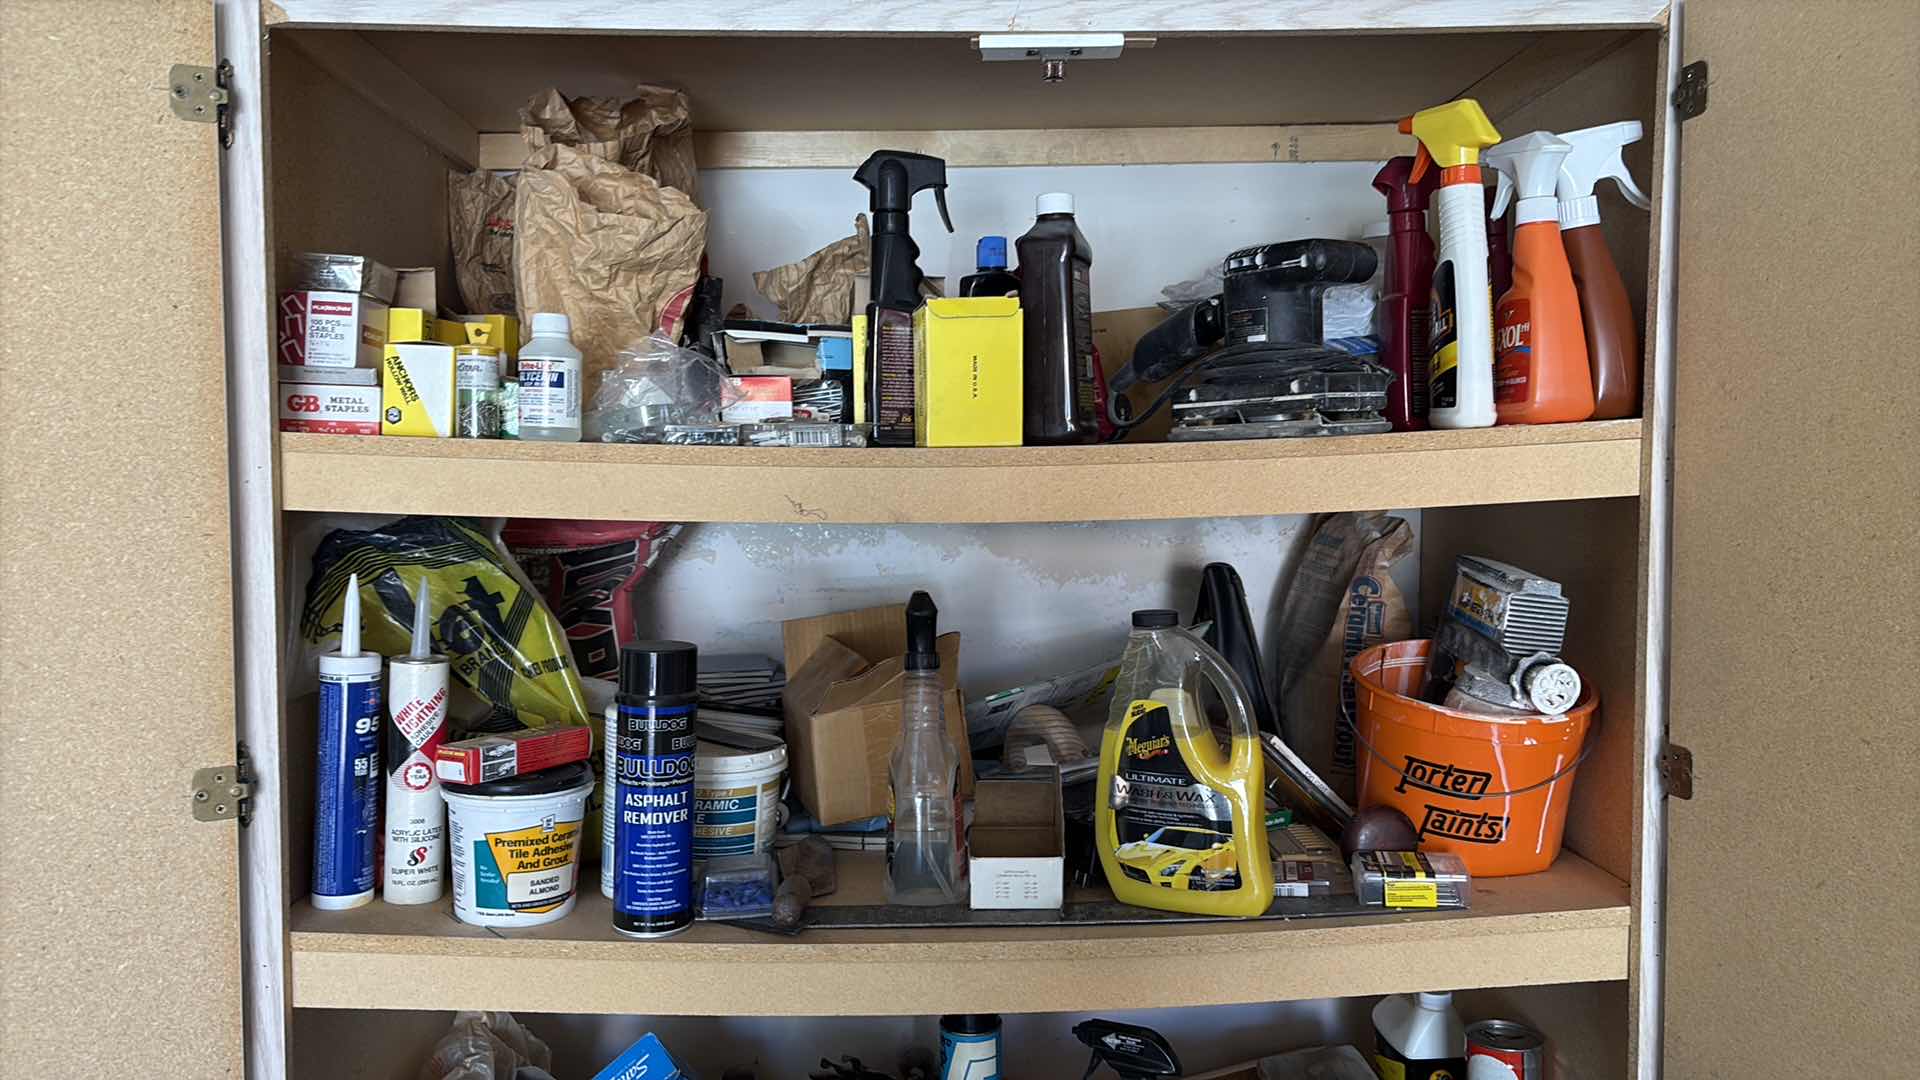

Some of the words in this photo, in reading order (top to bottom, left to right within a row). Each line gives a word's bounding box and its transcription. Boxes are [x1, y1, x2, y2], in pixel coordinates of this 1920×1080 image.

[309, 333, 345, 341] STAPLES
[310, 326, 336, 334] CABLE
[385, 357, 402, 387] HOLLOW
[400, 386, 412, 406] WALL
[391, 355, 420, 402] ANCHORS
[287, 395, 321, 413] GB
[329, 396, 365, 405] METAL
[324, 404, 370, 413] STAPLES
[394, 699, 424, 725] WHITE
[401, 687, 447, 735] LIGHTNING
[354, 716, 380, 735] 95
[410, 709, 441, 740] ADHESIVE
[628, 718, 688, 731] BULLDOG
[415, 725, 436, 746] CAULK
[354, 757, 369, 770] 55
[1125, 773, 1186, 785] ULTIMATE
[1394, 754, 1493, 801] Porter
[625, 791, 689, 808] ASPHALT
[1175, 790, 1217, 803] WAX
[623, 808, 689, 826] REMOVER
[1417, 804, 1511, 844] Paints
[392, 829, 421, 838] ACRYLIC
[392, 836, 409, 844] WITH
[495, 833, 549, 848] Premixed
[509, 849, 530, 859] Tile
[392, 867, 416, 875] SUPER
[417, 864, 440, 874] WHITE
[517, 859, 541, 871] And
[543, 854, 570, 867] Grout
[530, 876, 560, 887] SANDED
[529, 885, 560, 896] ALMOND
